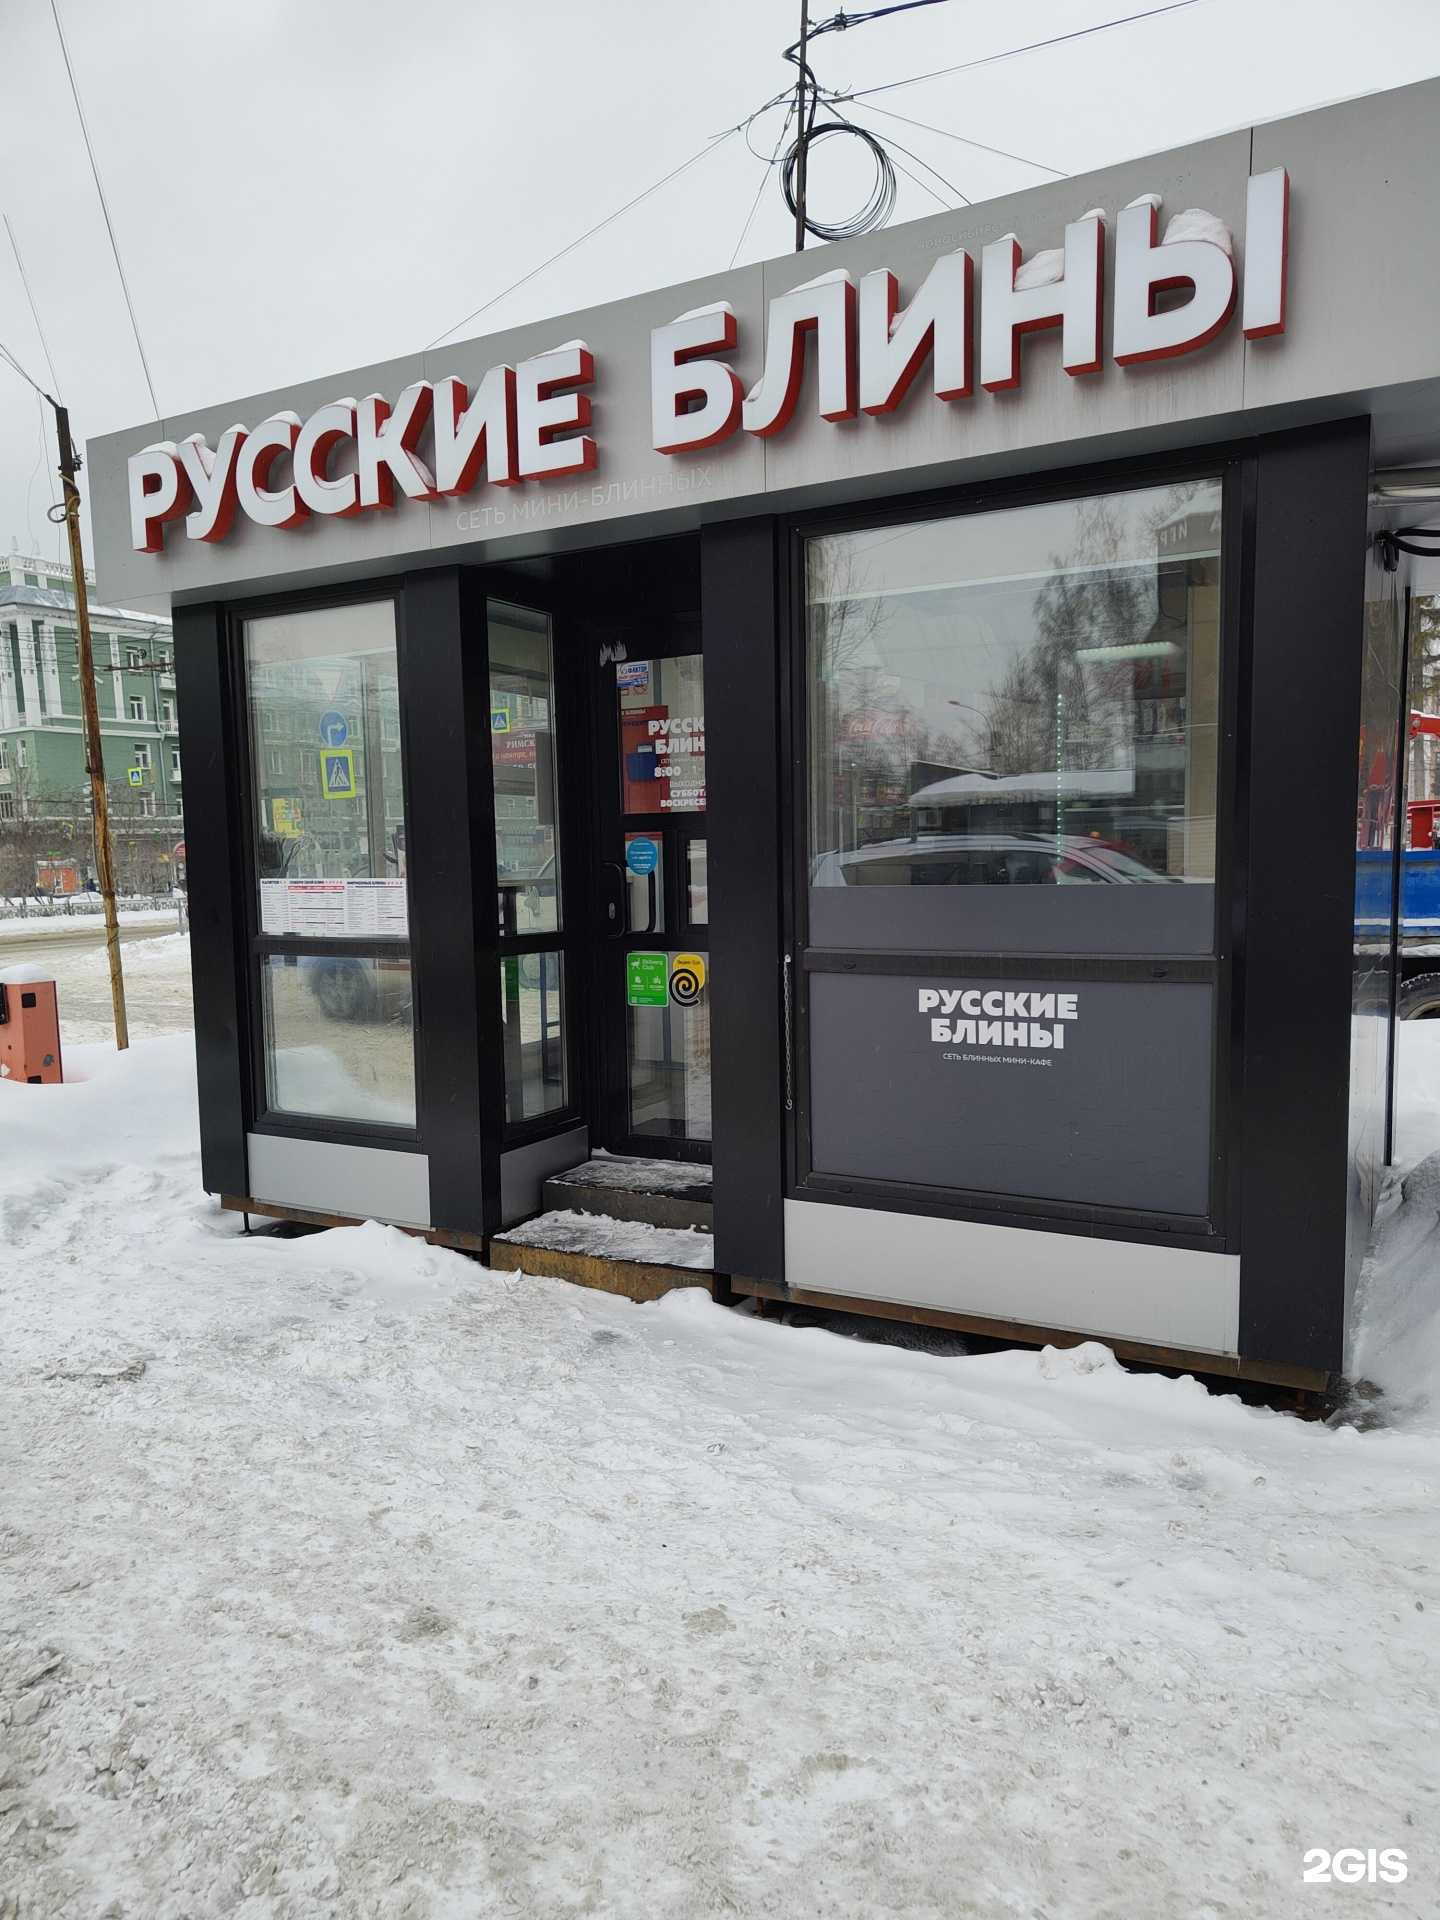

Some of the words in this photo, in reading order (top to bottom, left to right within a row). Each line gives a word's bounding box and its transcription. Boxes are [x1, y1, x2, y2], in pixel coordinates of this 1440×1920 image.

[128, 346, 597, 553] РУССКИЕ
[651, 167, 1289, 454] БЛИНЫ
[455, 504, 506, 532] СЕТЬ
[511, 466, 712, 522] МИНИ-БЛИННЫХ
[654, 766, 681, 777] 8:00
[670, 789, 706, 797] СУББОТ
[918, 989, 1078, 1020] РУССКИЕ
[931, 1018, 1064, 1049] БЛИНЫ
[943, 1053, 961, 1061] СЕТЬ
[962, 1054, 1001, 1063] БЛИННЫХ
[1002, 1057, 1052, 1066] МИНИ-КАФЕ
